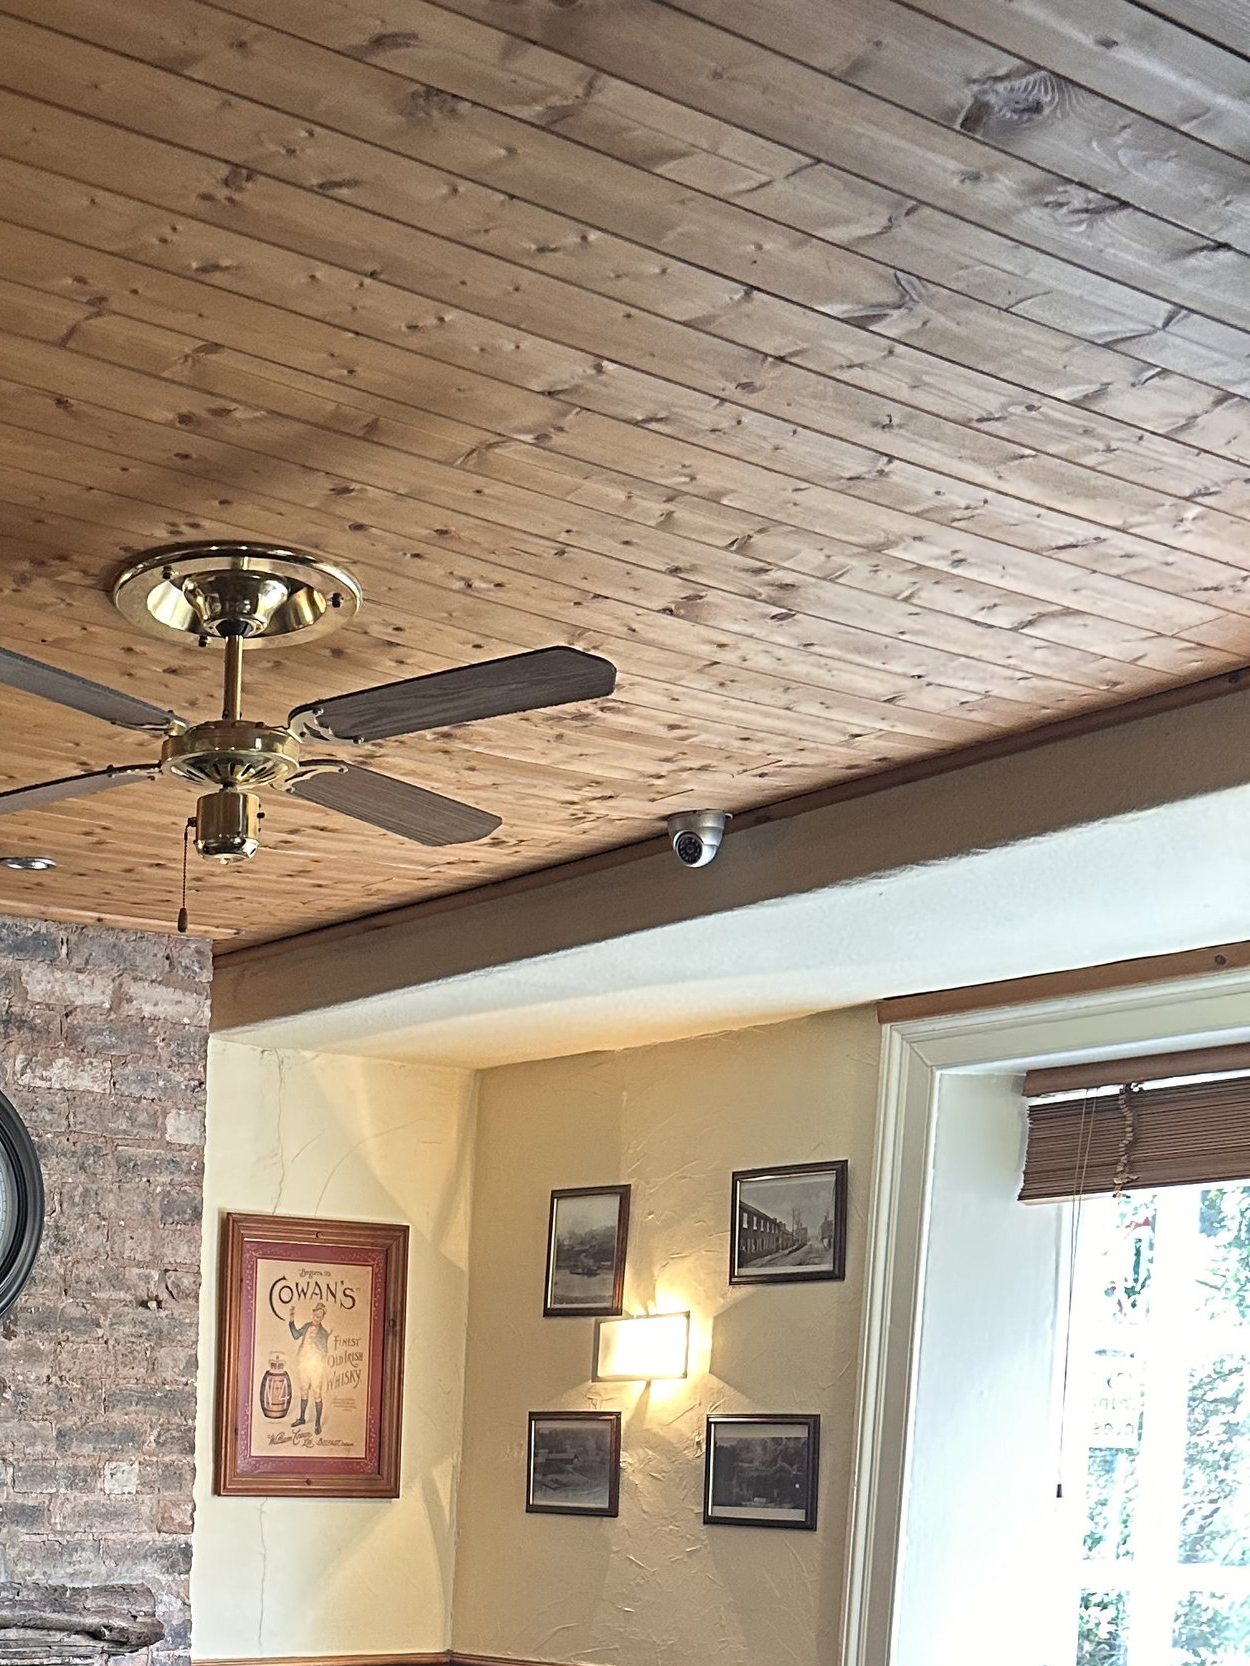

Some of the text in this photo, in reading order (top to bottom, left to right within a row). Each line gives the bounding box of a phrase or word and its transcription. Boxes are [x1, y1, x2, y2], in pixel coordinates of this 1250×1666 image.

[269, 1276, 356, 1321] COWAN'S
[334, 1335, 362, 1350] FINEST
[327, 1350, 363, 1368] OLD IRISH
[326, 1369, 362, 1391] WHISKY
